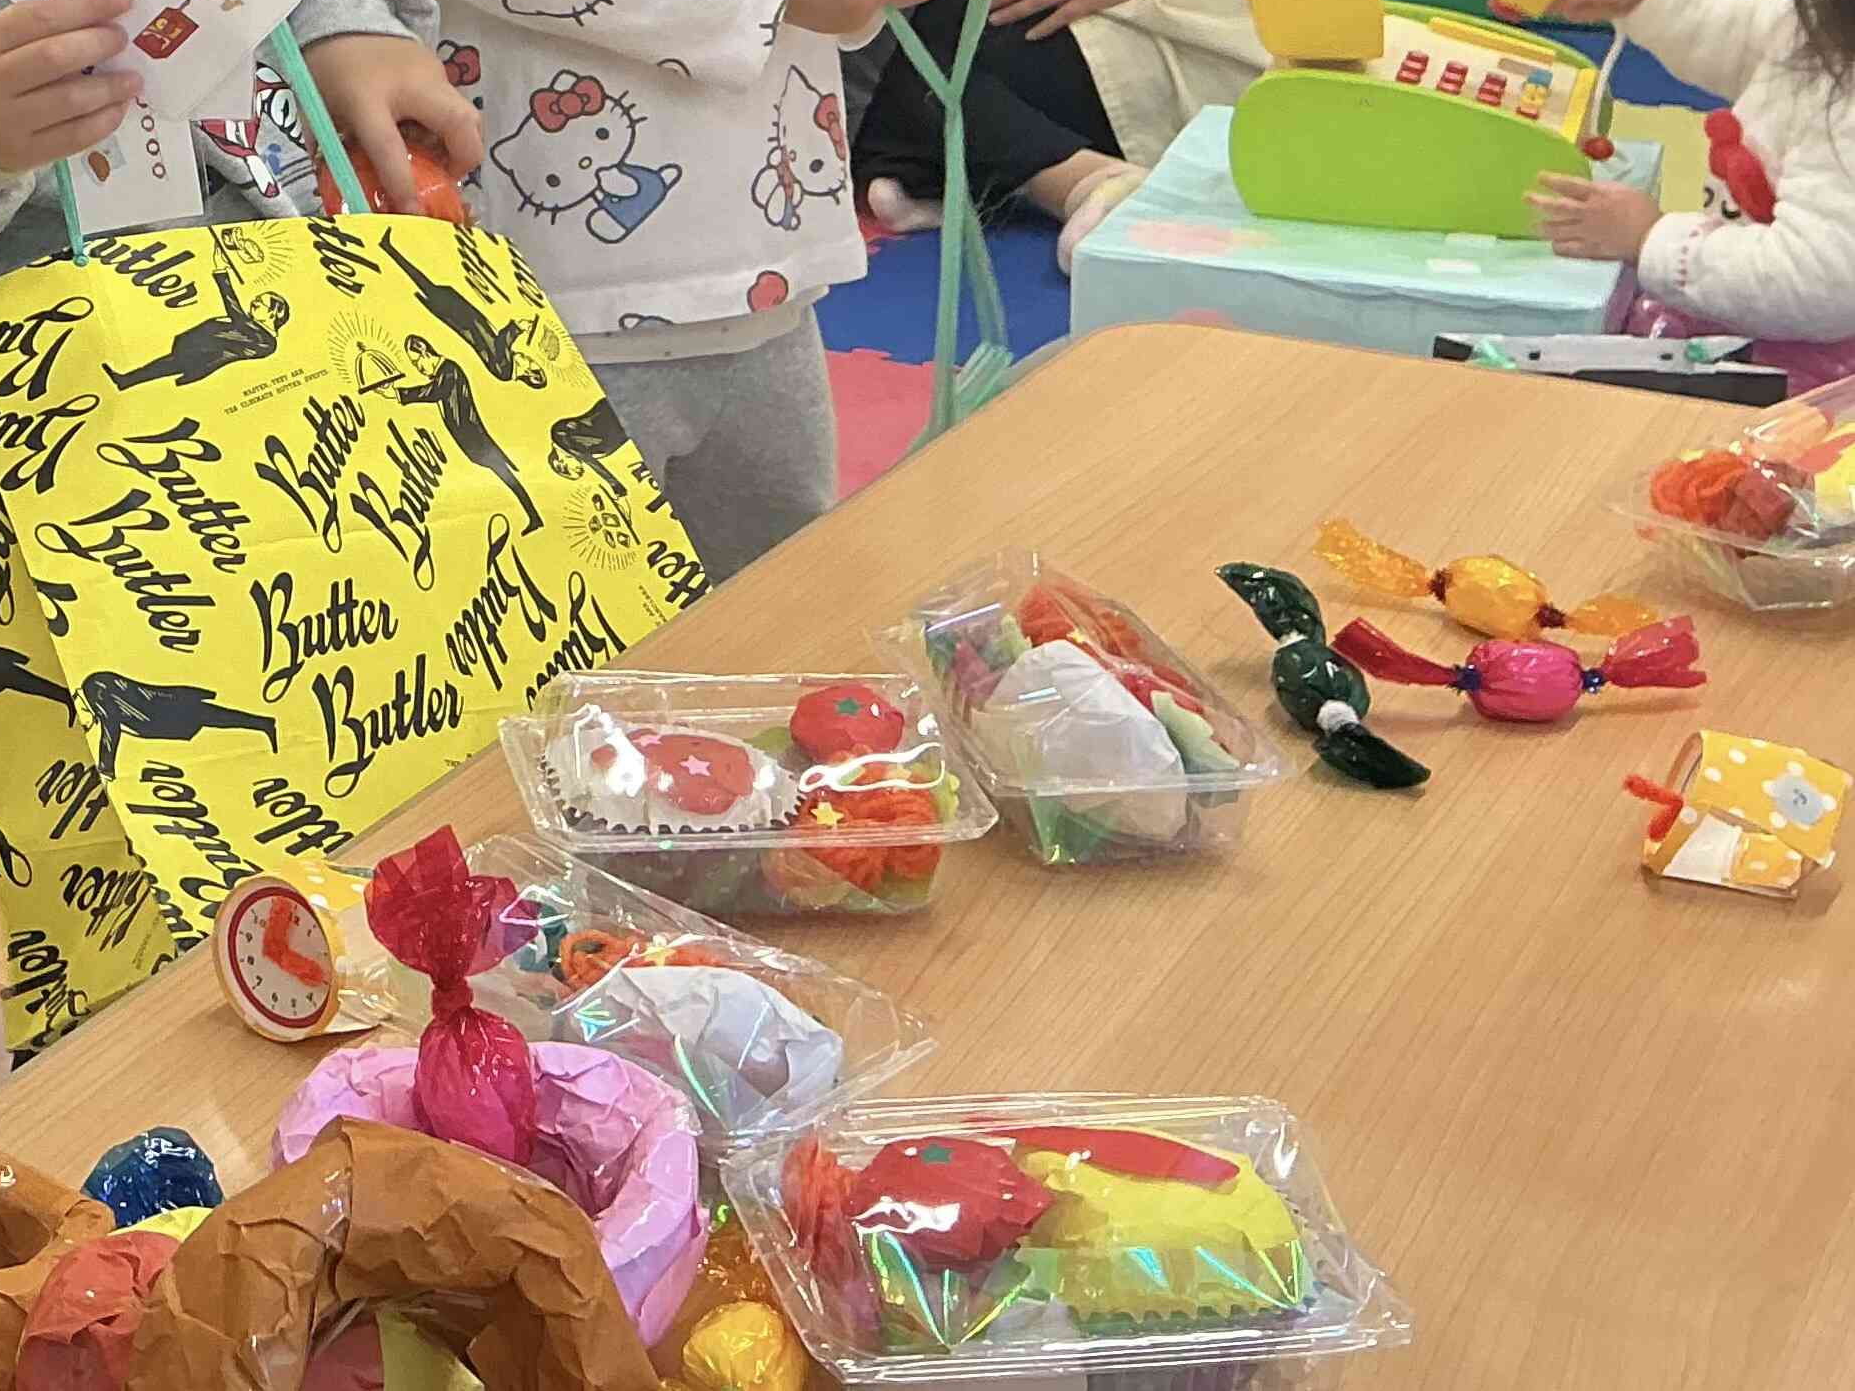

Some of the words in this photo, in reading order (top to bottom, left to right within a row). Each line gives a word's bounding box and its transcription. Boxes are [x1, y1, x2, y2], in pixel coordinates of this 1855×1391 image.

[96, 417, 251, 573] Butter
[254, 395, 367, 554] Butter
[349, 418, 448, 592] Butler
[34, 488, 201, 653] Butler
[251, 570, 399, 704] Butter
[312, 652, 464, 798] Butler
